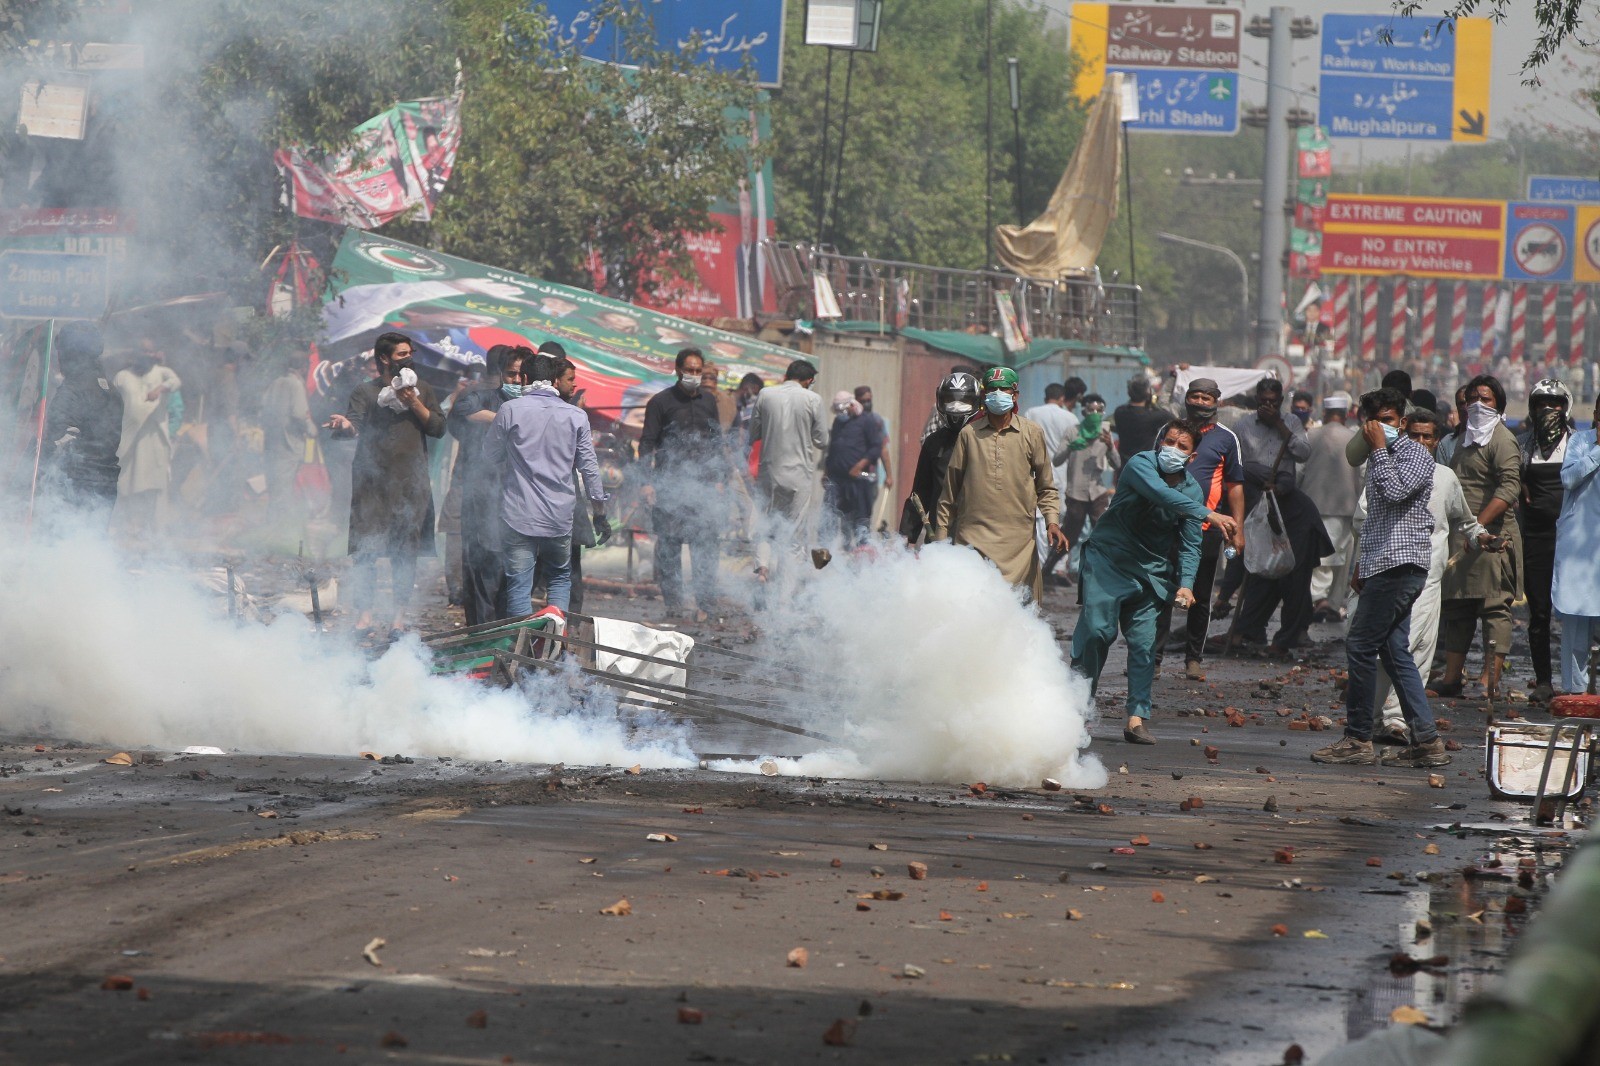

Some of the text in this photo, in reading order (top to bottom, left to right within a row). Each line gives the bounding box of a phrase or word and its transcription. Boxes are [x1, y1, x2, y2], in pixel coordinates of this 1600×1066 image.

[1108, 44, 1238, 66] Railway Station
[1323, 53, 1451, 76] Railway Workshop
[1139, 109, 1224, 128] rhi Shahu
[1332, 115, 1437, 137] Mughalpura
[1331, 204, 1482, 225] EXTREME CAUTION
[1362, 237, 1447, 254] NO ENTRY
[1334, 251, 1473, 272] For Heavy Vehicles
[8, 263, 101, 286] Zaman Park
[18, 290, 57, 306] Lane
